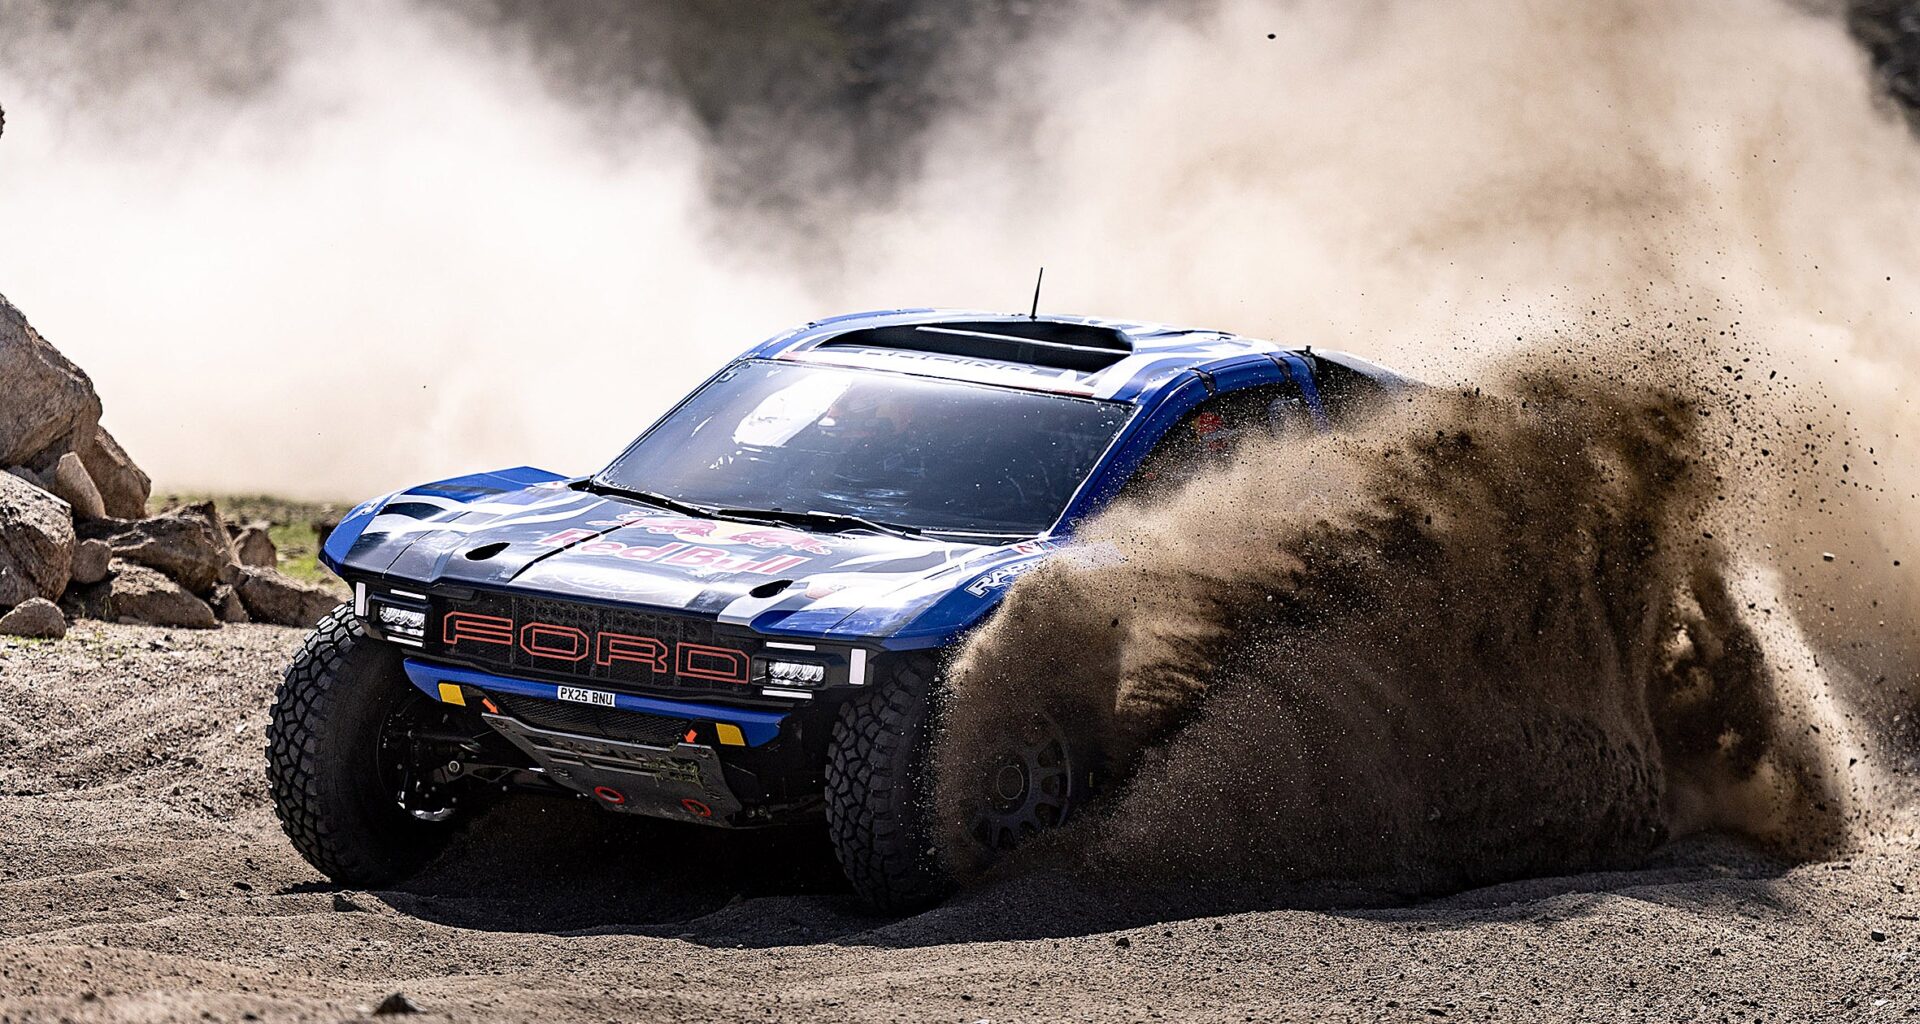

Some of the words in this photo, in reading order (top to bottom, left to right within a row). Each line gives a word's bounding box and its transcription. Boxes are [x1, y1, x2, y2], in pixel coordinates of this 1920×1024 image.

[538, 528, 686, 561] Red
[658, 546, 810, 575] Bull
[443, 611, 750, 684] FORD
[560, 687, 588, 702] PX25
[592, 692, 613, 705] BNU
